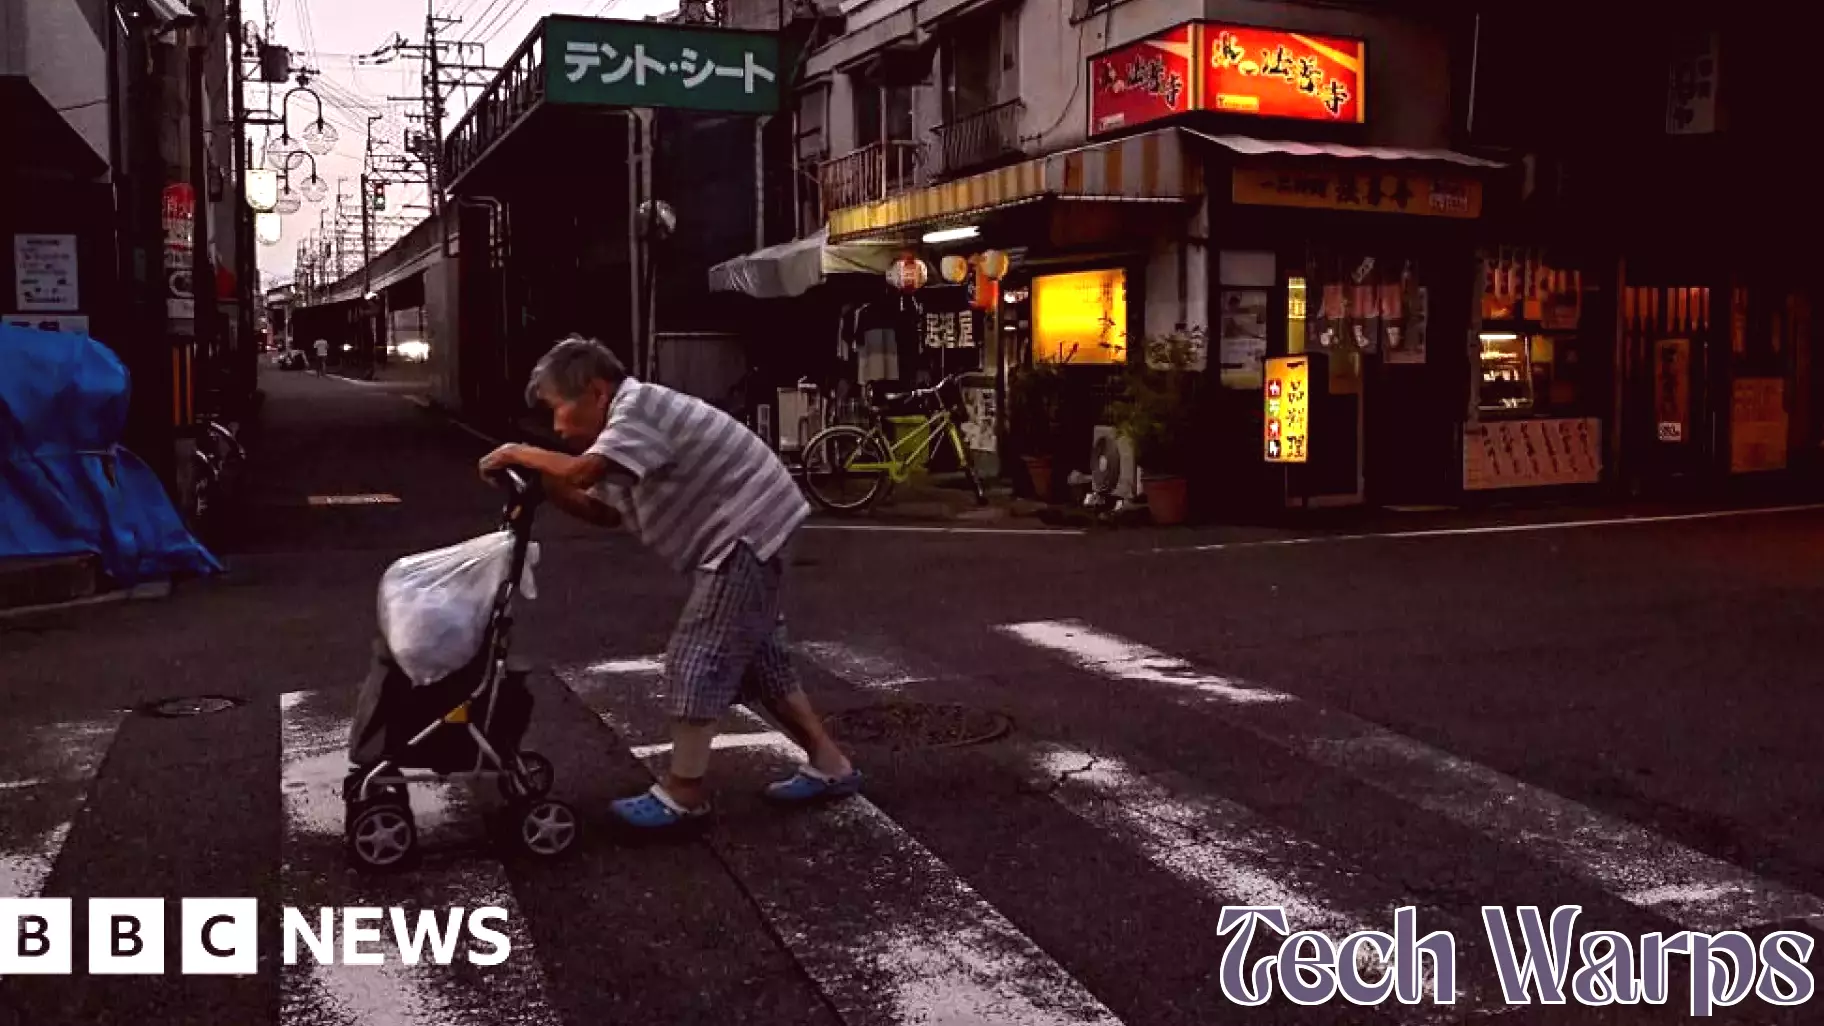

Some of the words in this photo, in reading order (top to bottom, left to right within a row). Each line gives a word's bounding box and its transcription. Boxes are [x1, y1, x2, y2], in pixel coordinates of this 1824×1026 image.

[564, 41, 776, 94] テント・シート
